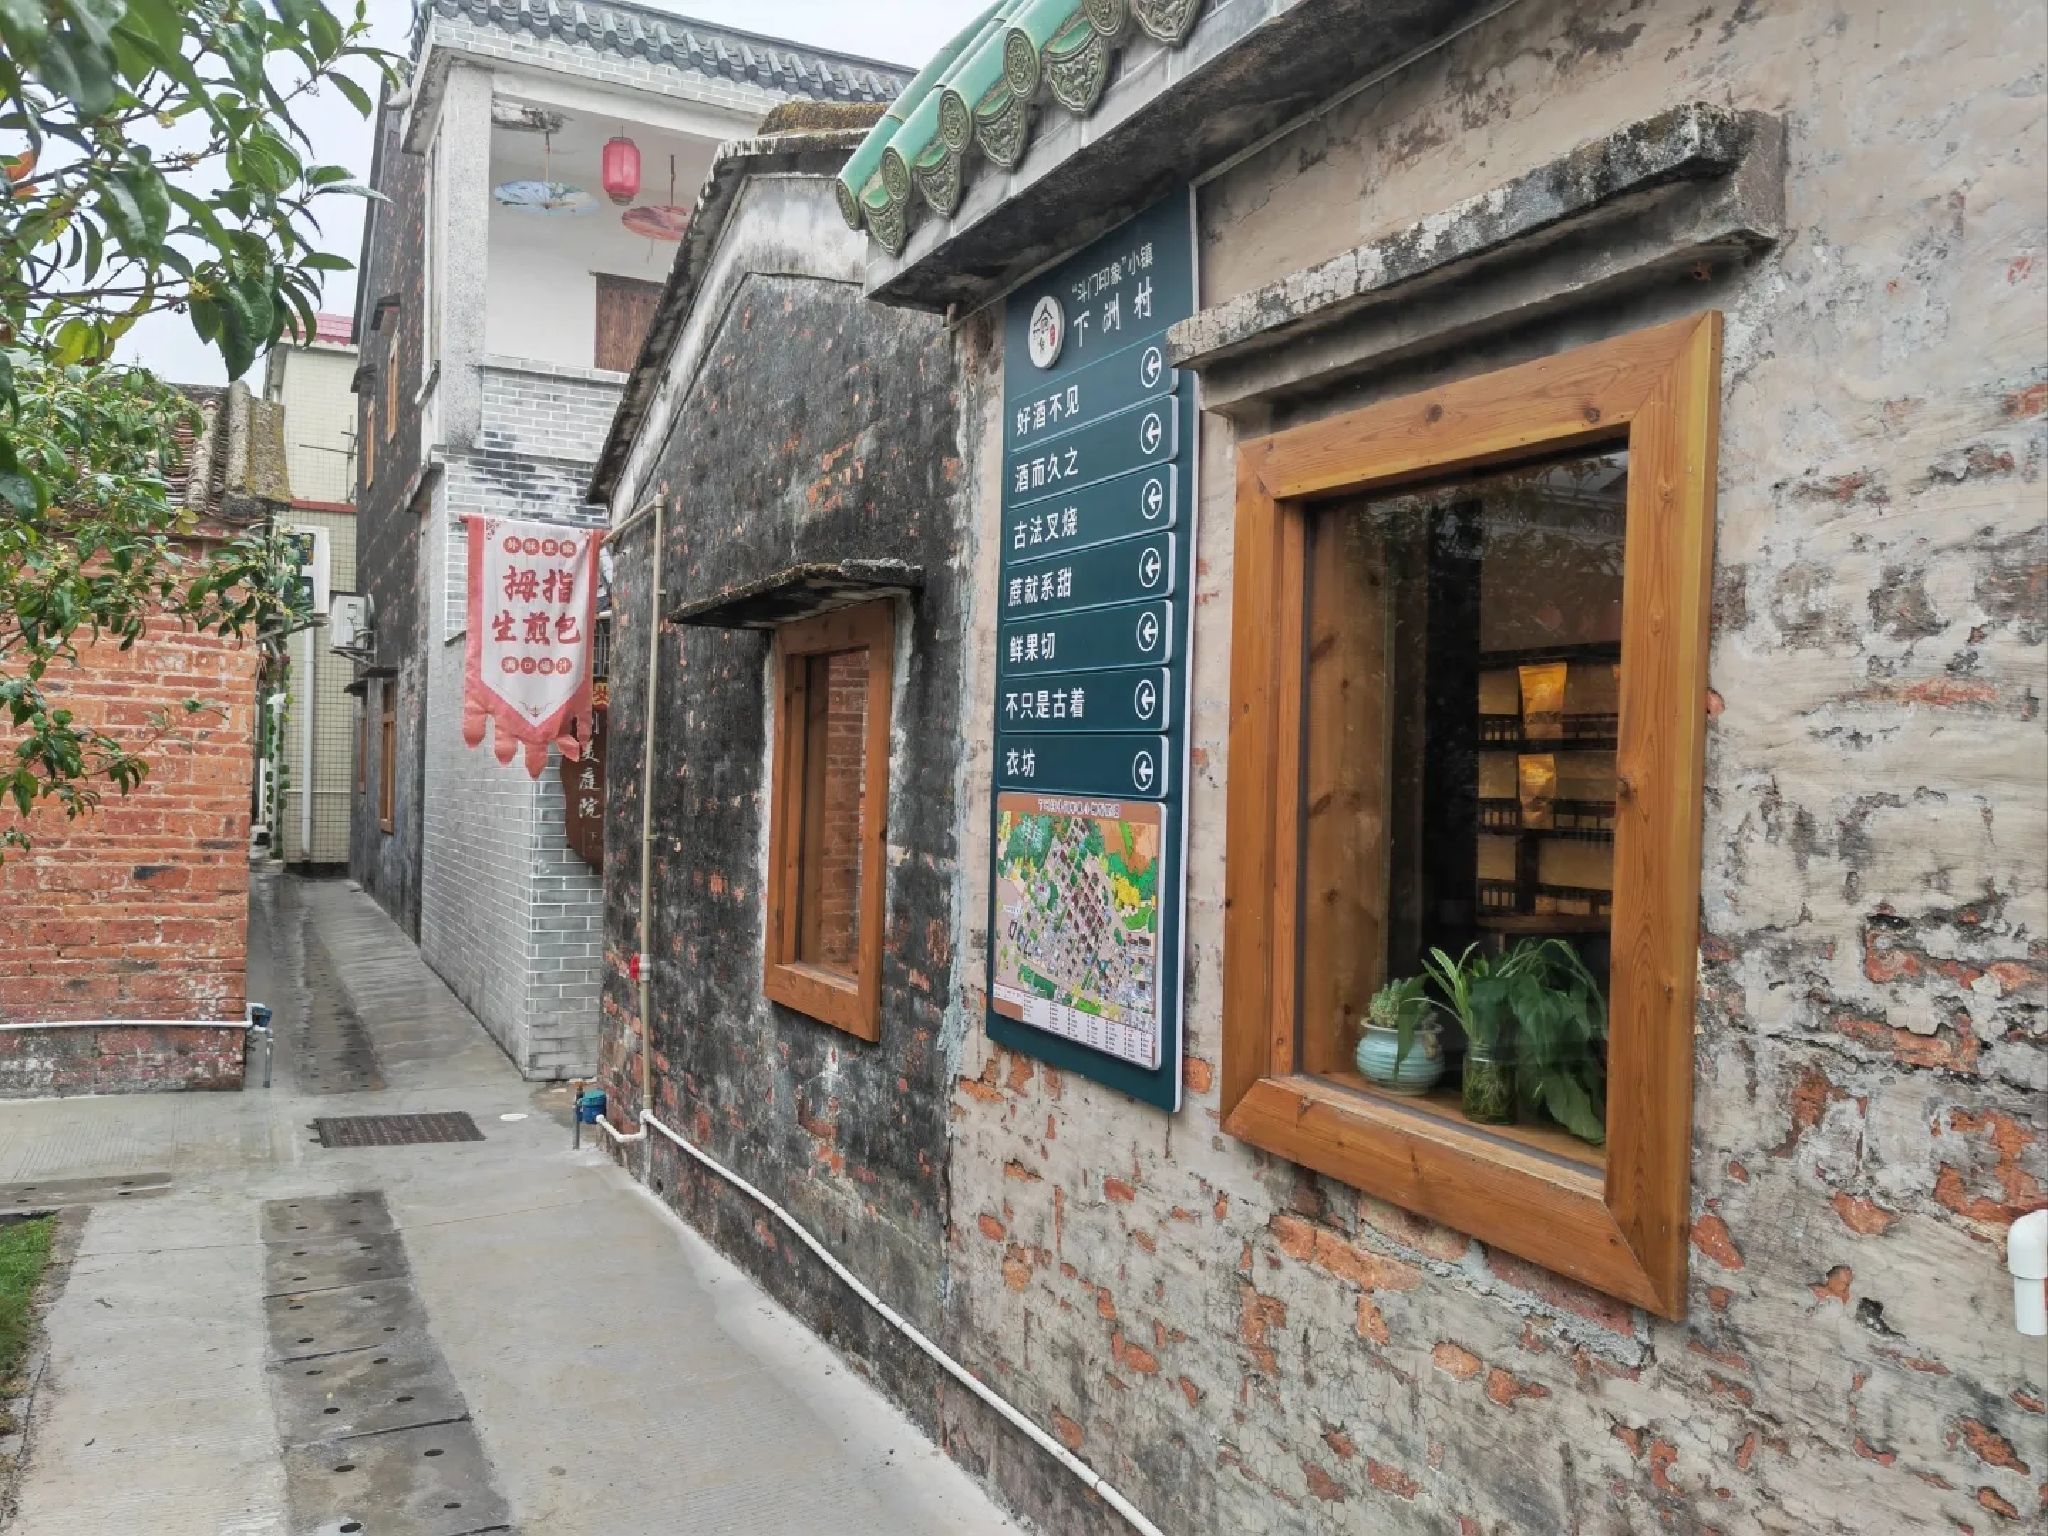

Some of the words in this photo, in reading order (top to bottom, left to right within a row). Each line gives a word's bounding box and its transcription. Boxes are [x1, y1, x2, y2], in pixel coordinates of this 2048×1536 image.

[1073, 276, 1153, 347] 下洲村
[1016, 384, 1079, 436] 好酒不见
[1014, 447, 1079, 493] 酒而久之
[1013, 506, 1078, 550] 古法叉烧
[503, 565, 573, 603] 拇指
[1007, 567, 1072, 607] 蔗就系甜
[492, 609, 581, 646] 生煎包
[1009, 632, 1056, 664] 鲜果切
[1005, 687, 1085, 720] 不只是古着
[1006, 748, 1036, 778] 衣坊
